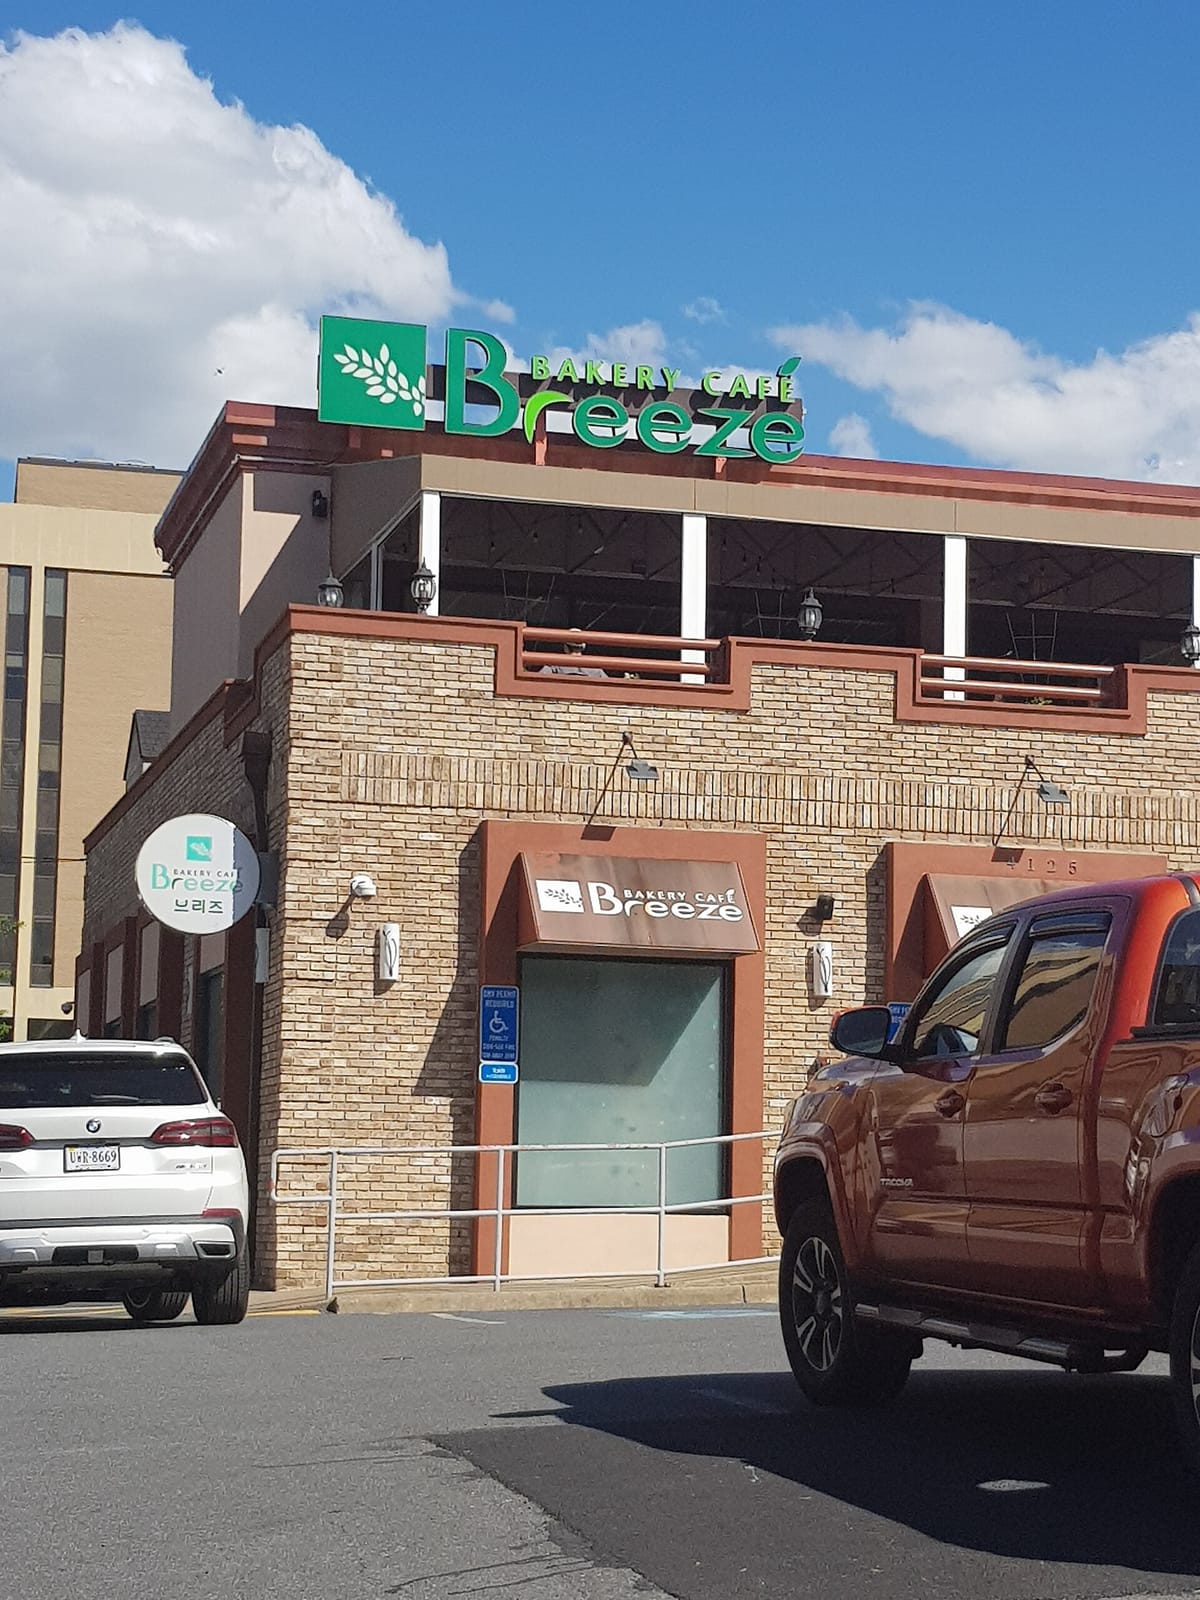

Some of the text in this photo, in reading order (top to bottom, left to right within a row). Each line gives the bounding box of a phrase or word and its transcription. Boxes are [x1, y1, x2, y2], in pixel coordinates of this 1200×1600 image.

[445, 327, 806, 464] Breeze
[531, 354, 803, 403] BAKERY CAFÉ
[152, 863, 243, 893] Breeze
[623, 889, 687, 901] BAKERY
[174, 899, 223, 914] 브리즈
[586, 881, 744, 922] Breeze
